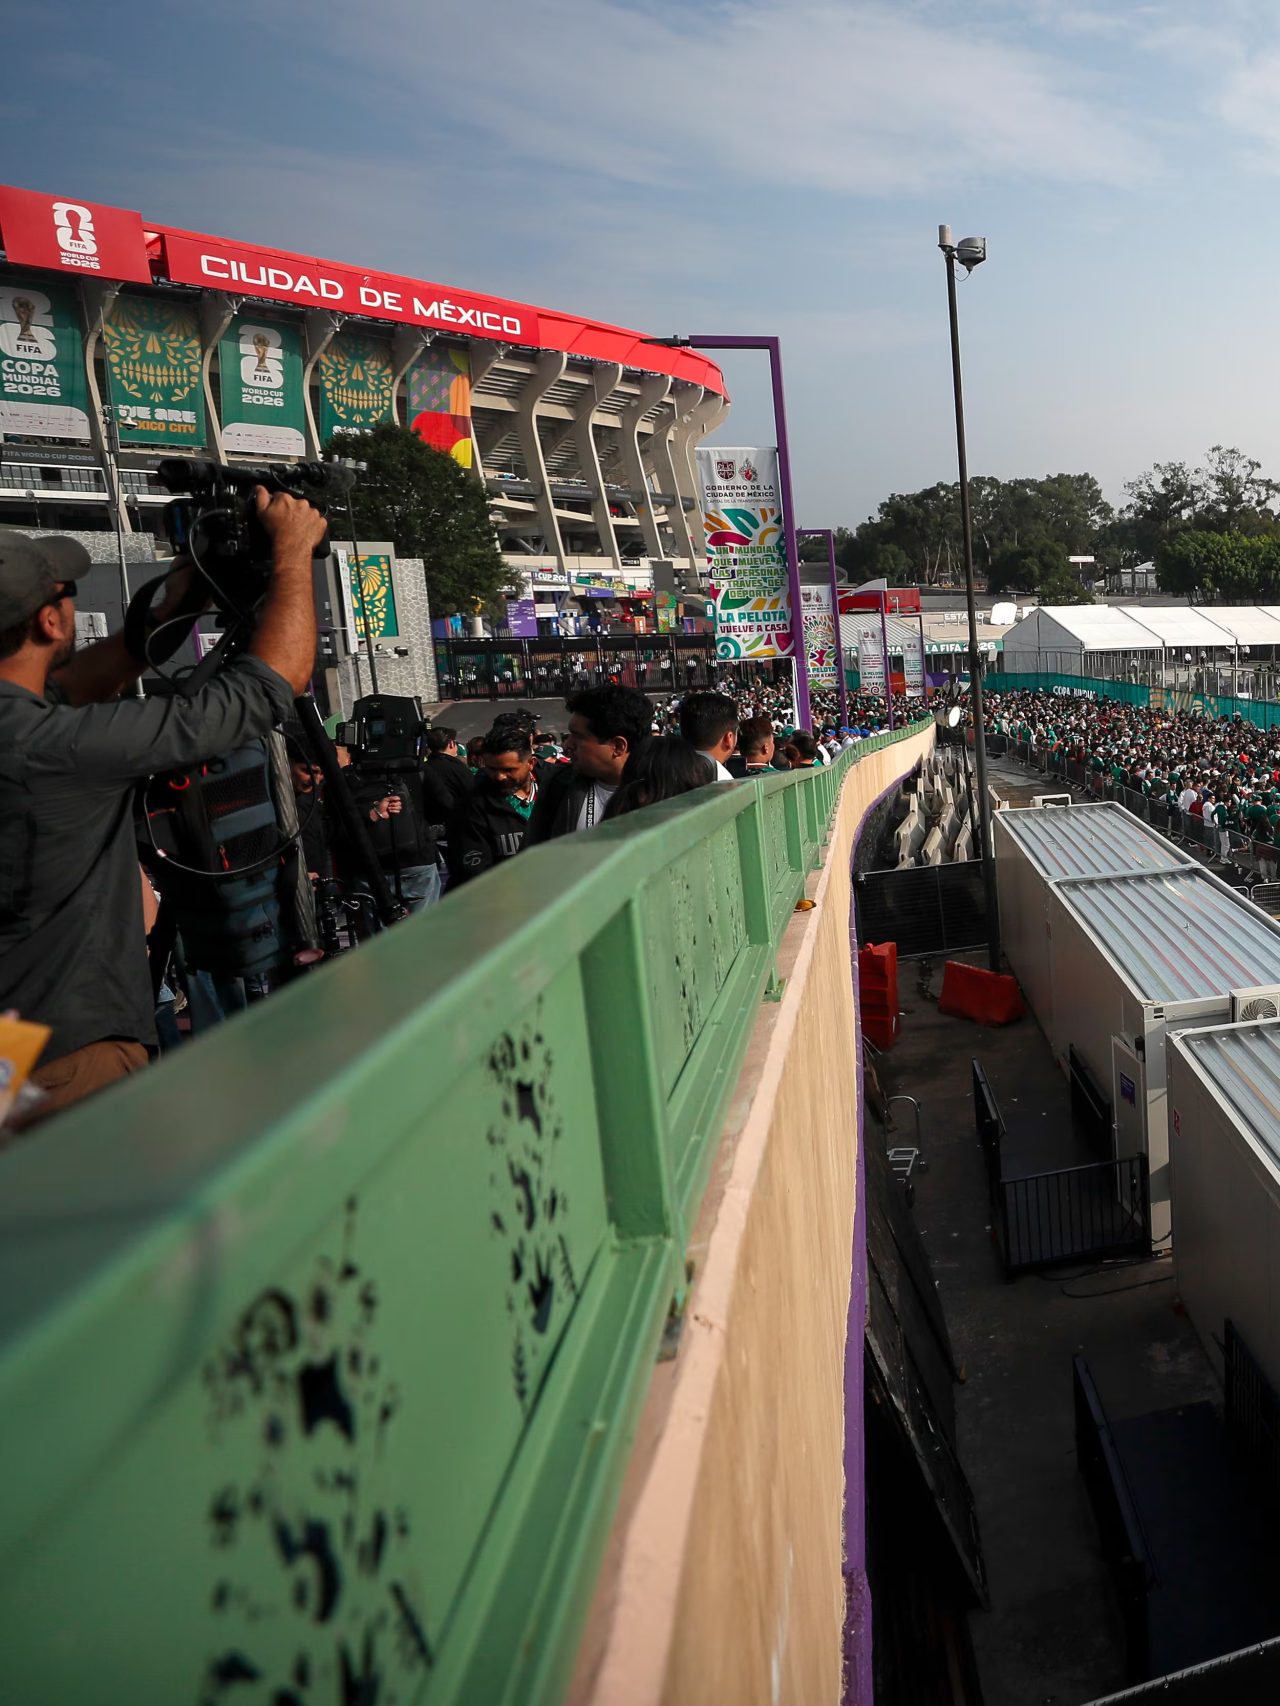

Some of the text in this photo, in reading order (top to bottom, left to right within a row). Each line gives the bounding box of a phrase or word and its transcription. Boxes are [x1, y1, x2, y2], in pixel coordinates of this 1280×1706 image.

[69, 241, 88, 250] FIFA
[60, 251, 85, 260] WORLD
[61, 257, 101, 270] 2026
[200, 254, 521, 335] CIUDAD DE MÉXICO
[16, 344, 42, 355] FIFA
[1, 359, 60, 378] COPA
[2, 372, 61, 387] MUNDIAL
[253, 374, 273, 382] FIFA
[4, 382, 62, 397] 2026
[241, 387, 269, 396] WORLD
[241, 394, 285, 407] 2026
[154, 408, 197, 424] ARE
[169, 423, 196, 434] CITY
[747, 490, 775, 498] MÉXICO
[716, 545, 778, 555] UN MUNDIAL
[713, 558, 733, 568] QUE
[740, 557, 772, 566] MUEVE
[712, 567, 786, 578] LAS PERSONAS
[768, 579, 786, 587] DEL
[730, 589, 773, 598] DEPORTE
[718, 611, 787, 623] LA PELOTA
[720, 625, 755, 634] VUELVE
[765, 624, 788, 632] CASA
[925, 644, 939, 653] LA
[940, 643, 962, 653] FIFA
